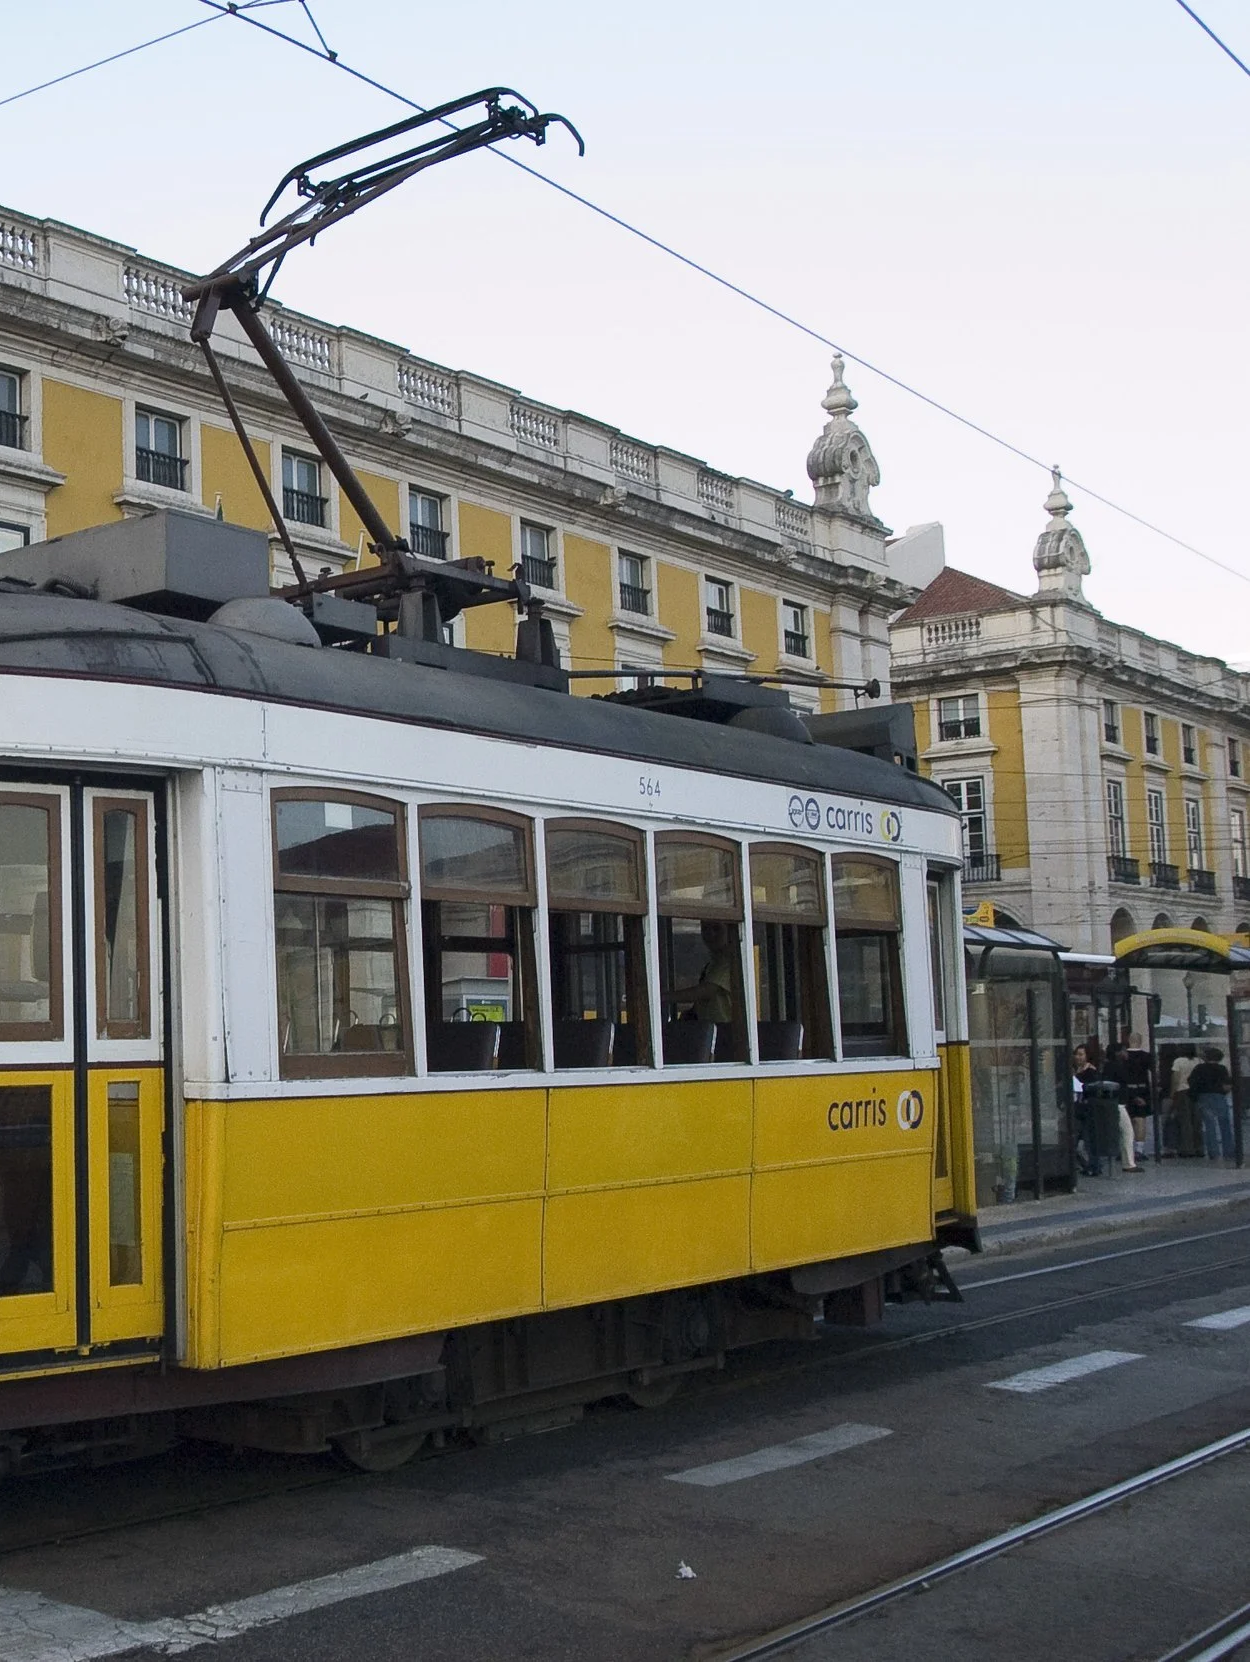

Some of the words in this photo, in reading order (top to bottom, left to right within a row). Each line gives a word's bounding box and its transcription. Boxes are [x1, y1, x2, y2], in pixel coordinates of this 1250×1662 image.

[639, 776, 661, 797] 564
[826, 800, 873, 835] carris
[827, 1087, 887, 1131] carris
